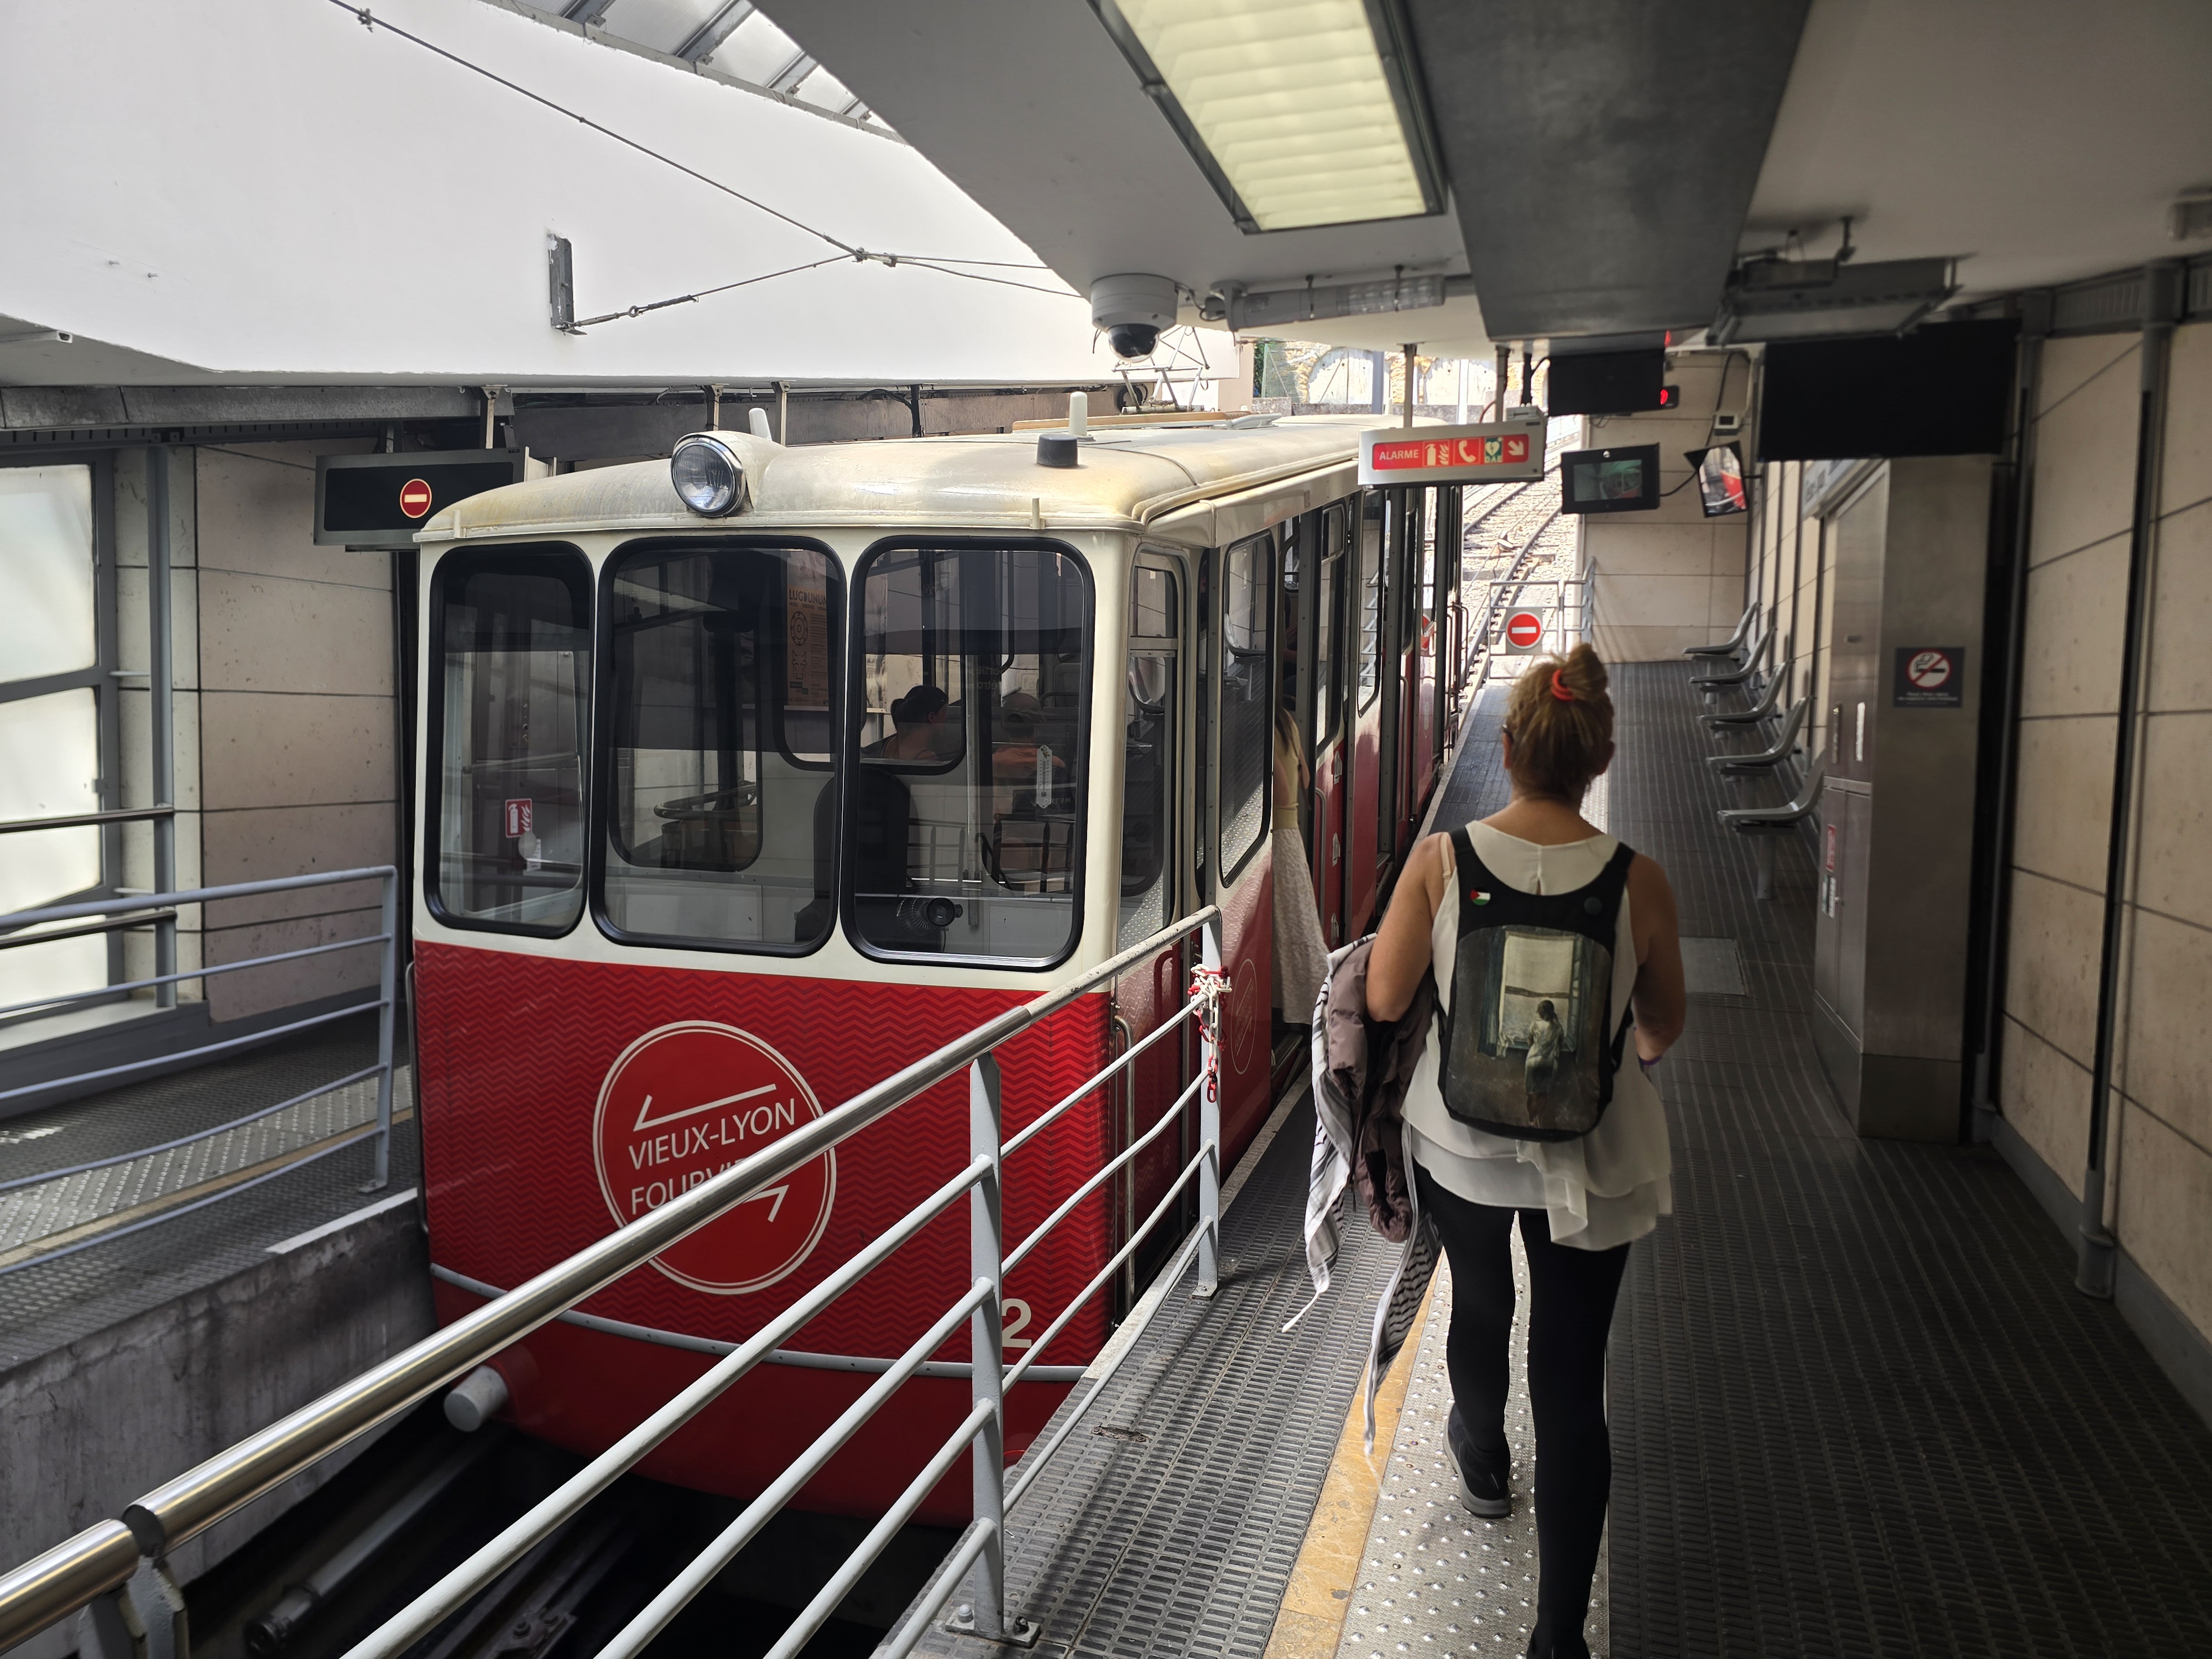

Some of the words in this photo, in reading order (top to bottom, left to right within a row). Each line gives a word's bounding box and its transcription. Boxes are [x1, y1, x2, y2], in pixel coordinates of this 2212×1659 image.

[1379, 449, 1419, 460] ALARME
[629, 1098, 795, 1170] VIEUX-LYON
[1001, 1298, 1032, 1348] 2
